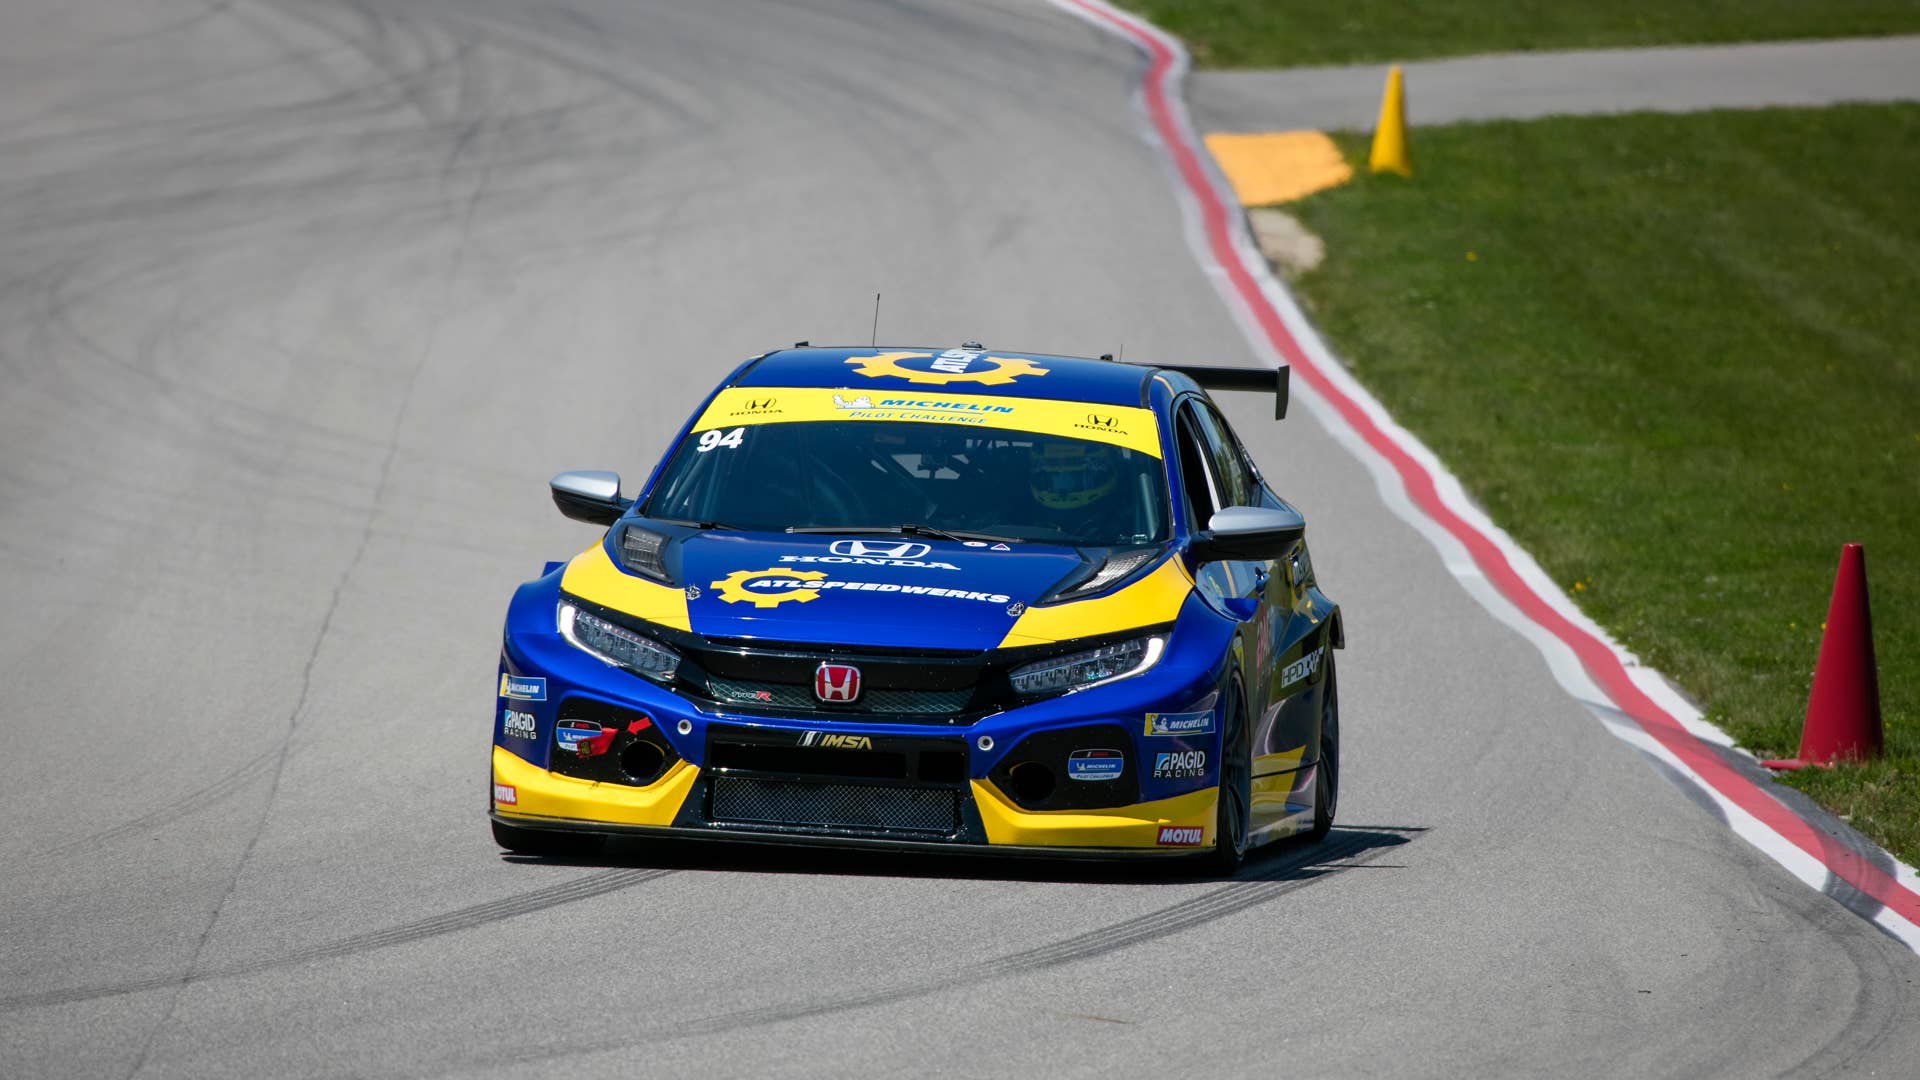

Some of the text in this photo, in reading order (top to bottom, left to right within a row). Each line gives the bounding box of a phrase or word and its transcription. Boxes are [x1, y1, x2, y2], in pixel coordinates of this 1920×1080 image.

[729, 409, 784, 417] HONDA
[880, 400, 1014, 414] MICHELIN
[849, 411, 987, 425] PILOT CHALLENGE
[1074, 423, 1129, 436] HONDA
[696, 427, 746, 452] 94
[779, 555, 961, 571] HONDA
[748, 579, 1010, 604] ATLSPEEDWERKS
[1282, 662, 1304, 687] HPD
[510, 683, 540, 694] MICHELIN
[511, 710, 536, 732] PAGID
[1169, 717, 1210, 730] MICHELIN
[504, 727, 537, 740] RACING
[820, 734, 873, 750] IMSA
[1169, 750, 1206, 770] PAGID
[1153, 768, 1205, 779] RACING
[1159, 827, 1202, 843] MOTUL
